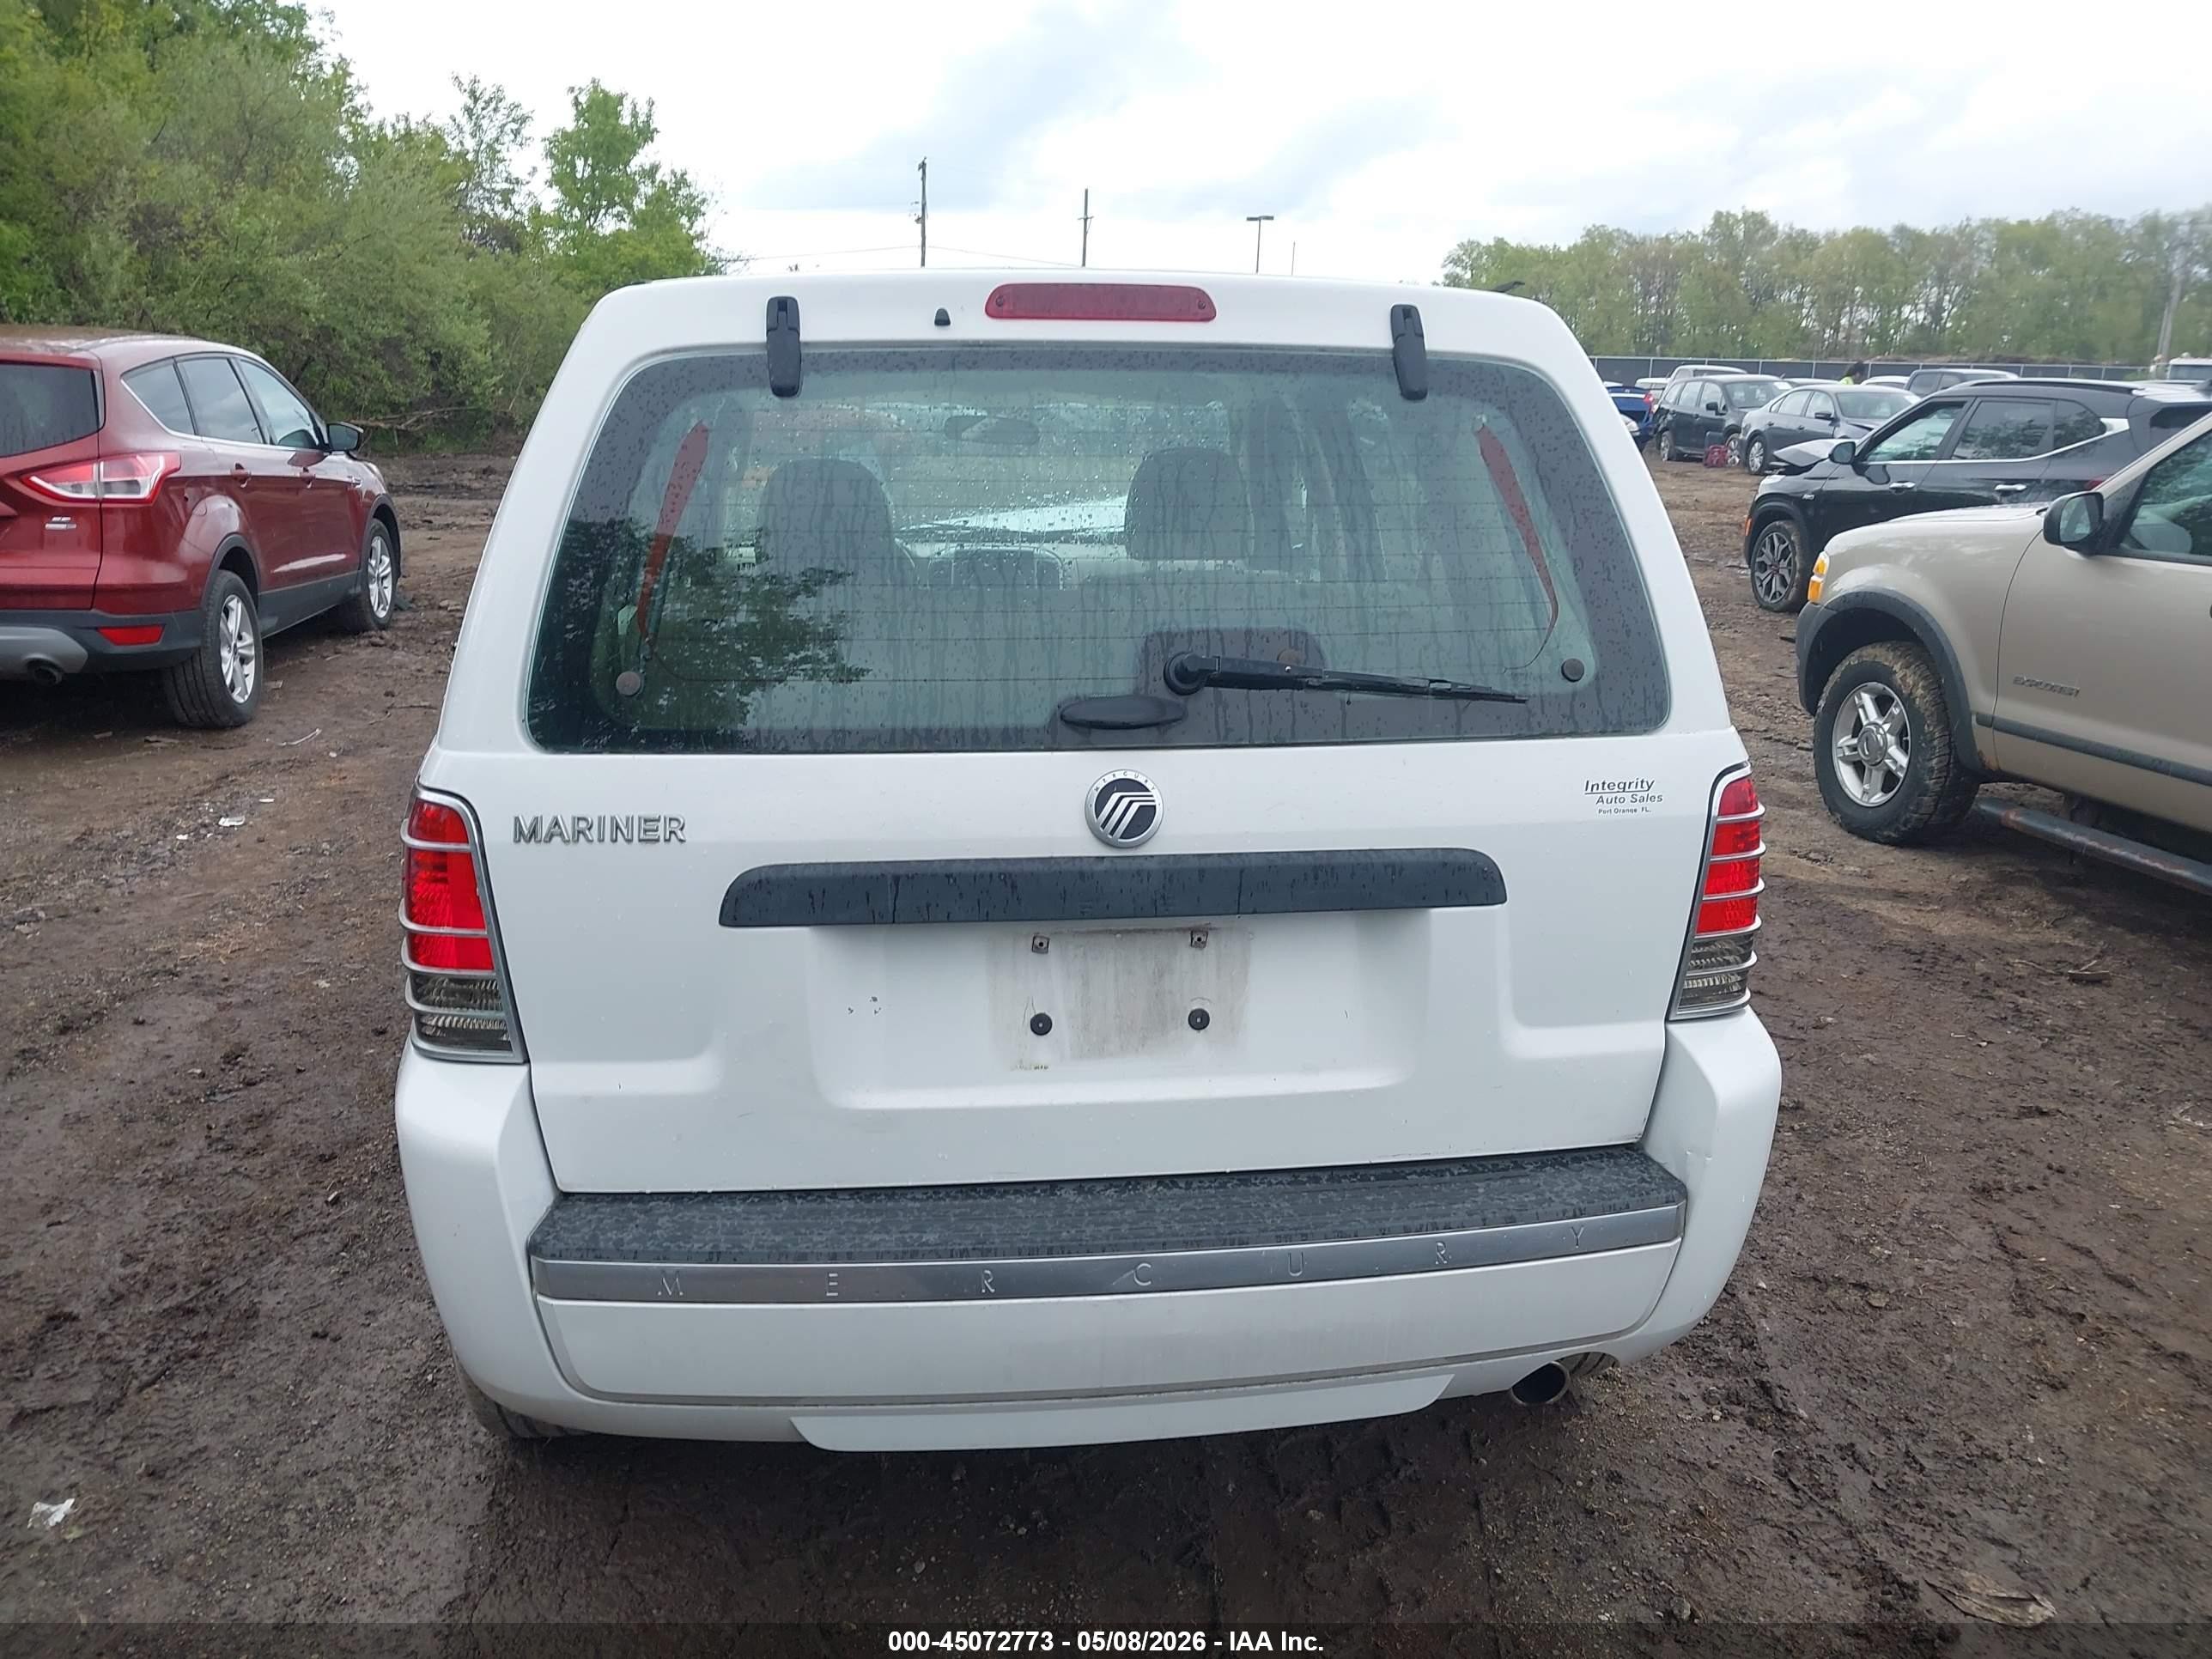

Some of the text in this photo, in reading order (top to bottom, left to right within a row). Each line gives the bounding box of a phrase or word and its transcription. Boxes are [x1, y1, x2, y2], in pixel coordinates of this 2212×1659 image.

[1584, 778, 1656, 793] Integrity
[1595, 793, 1663, 805] Auto Sales
[513, 814, 687, 843] MARINER
